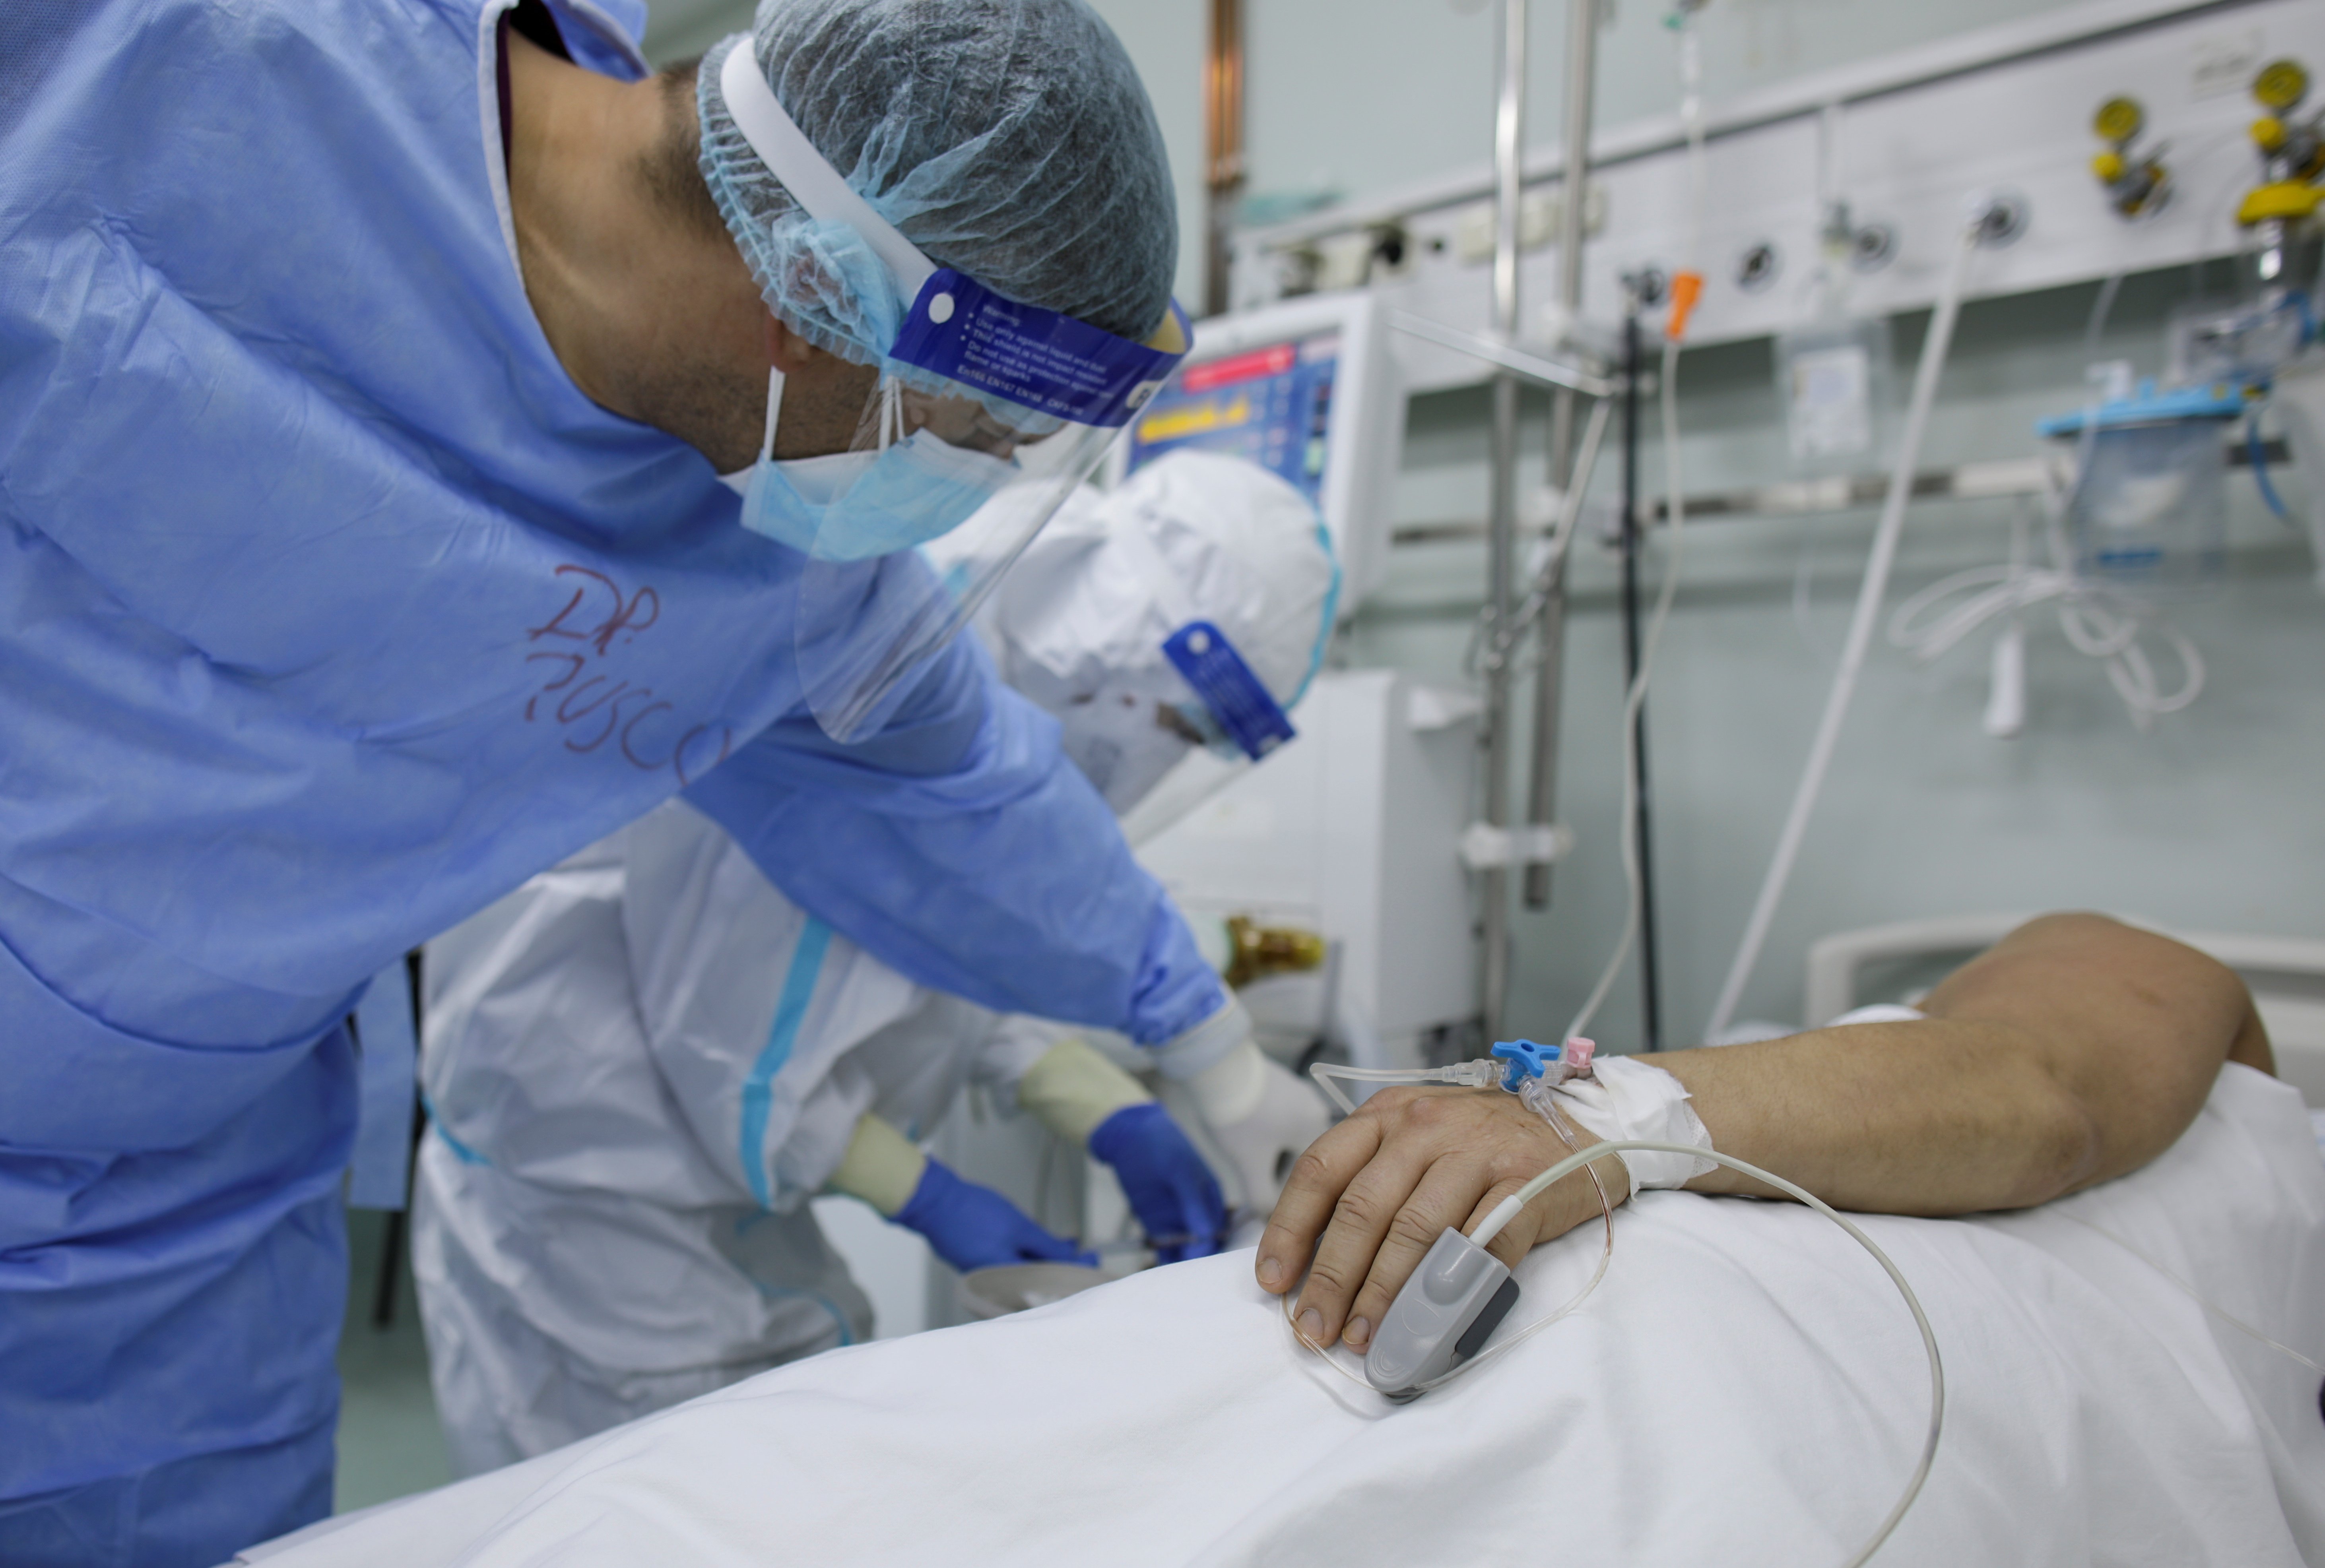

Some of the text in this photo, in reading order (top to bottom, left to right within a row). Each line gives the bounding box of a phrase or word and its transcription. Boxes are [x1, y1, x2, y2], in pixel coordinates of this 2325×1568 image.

[968, 340, 981, 351] Do
[982, 348, 998, 358] not
[999, 355, 1015, 364] use
[1028, 366, 1069, 384] protection
[976, 318, 993, 330] Use
[995, 327, 1014, 340] only
[1016, 335, 1048, 351] against
[1049, 347, 1073, 361] liquid
[1074, 358, 1089, 367] and
[994, 339, 1020, 354] shield
[1031, 354, 1046, 362] not
[1048, 361, 1074, 373] impact
